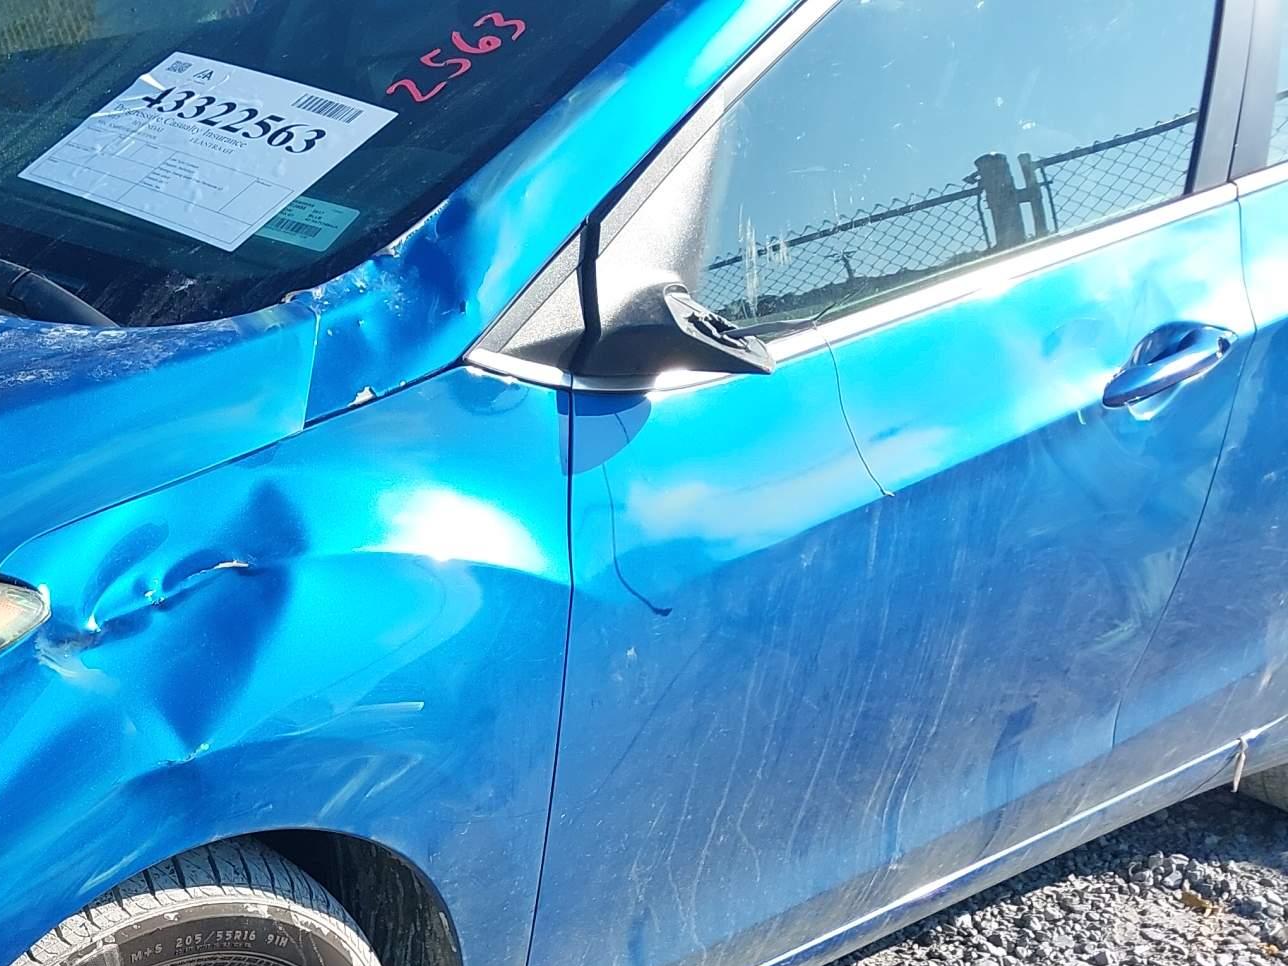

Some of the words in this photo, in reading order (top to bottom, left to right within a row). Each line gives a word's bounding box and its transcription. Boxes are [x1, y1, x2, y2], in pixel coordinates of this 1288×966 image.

[386, 12, 526, 102] 2563
[142, 86, 326, 153] 43322563
[164, 117, 202, 135] Casualty
[202, 128, 248, 149] Insurance
[266, 933, 289, 948] 91H
